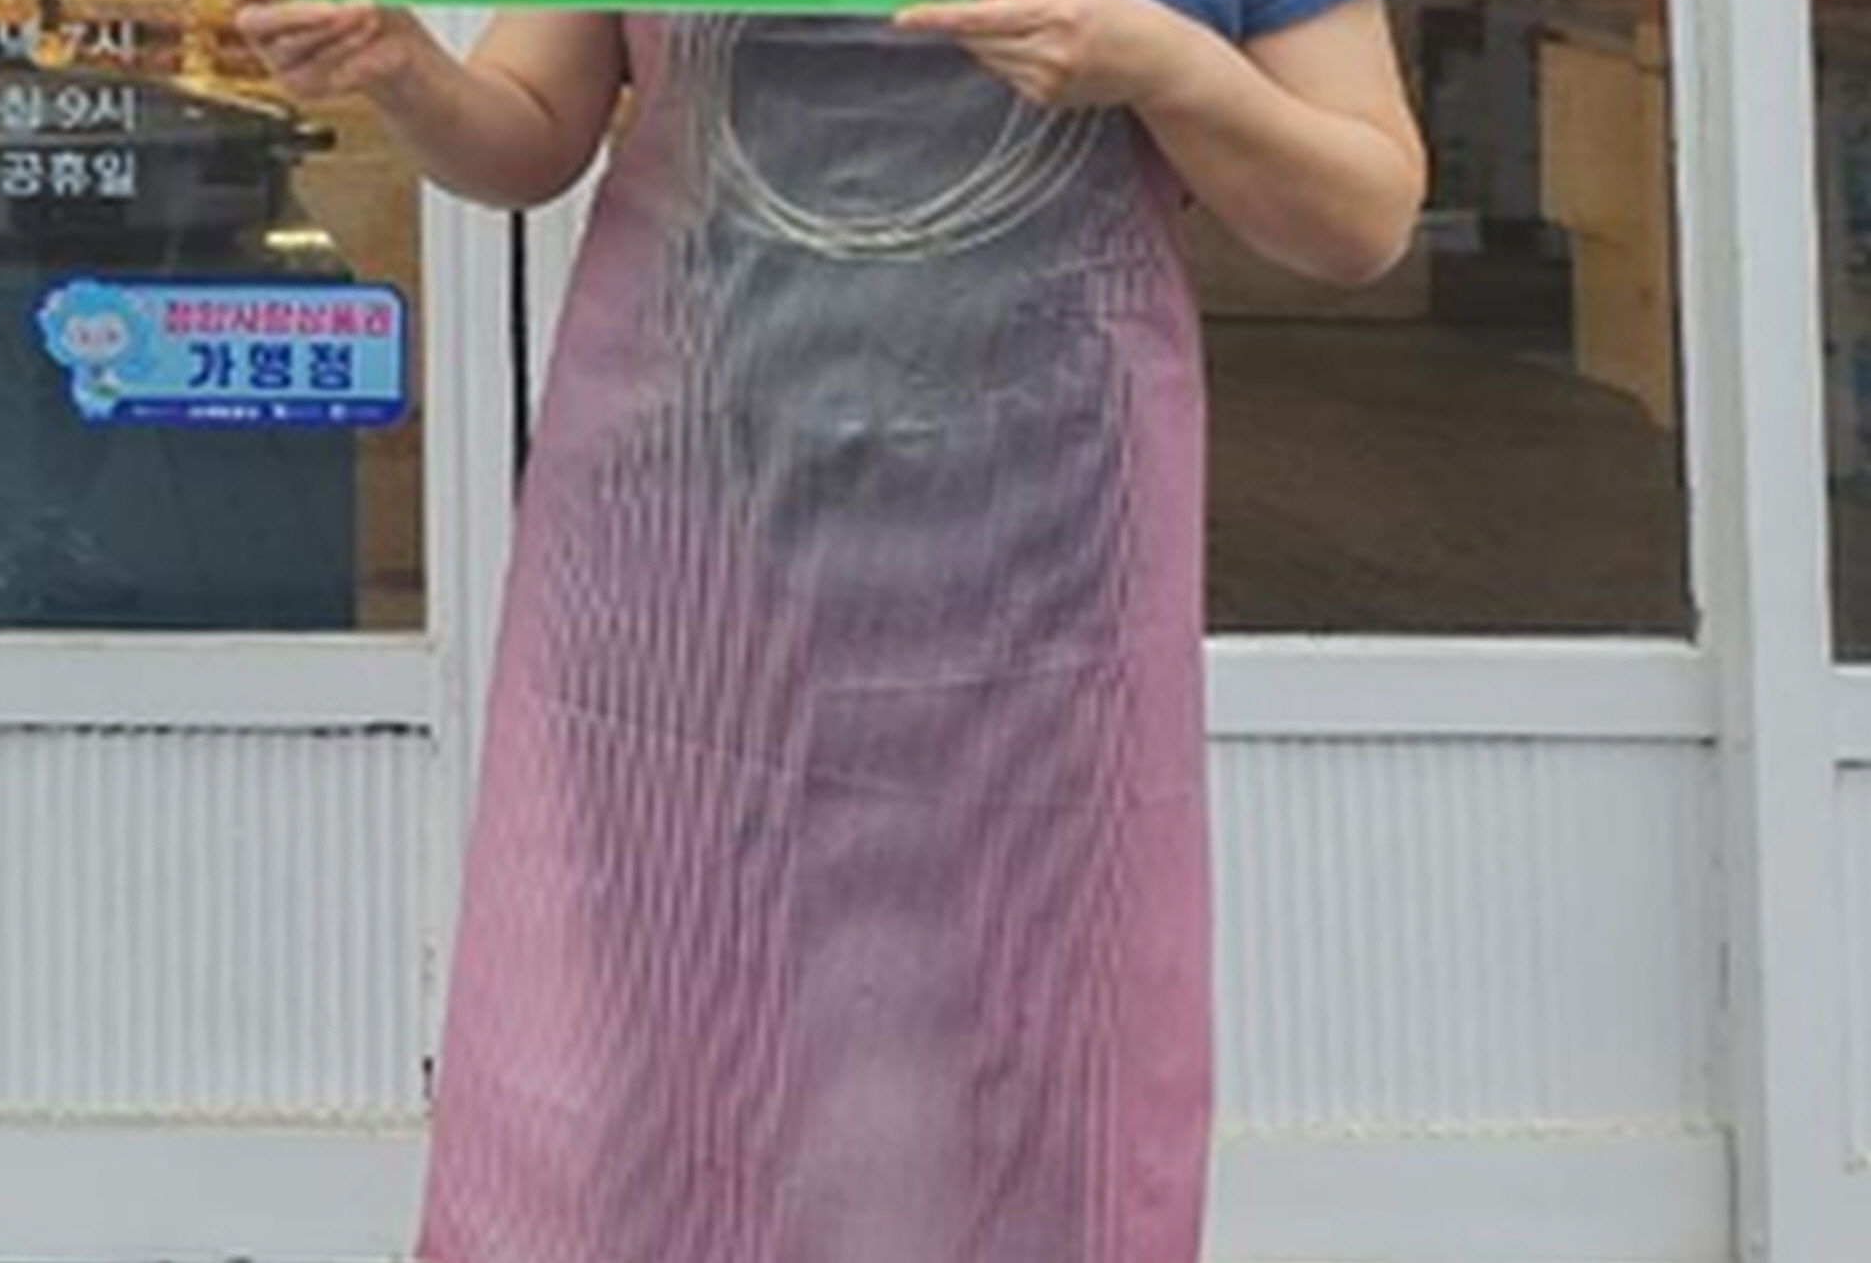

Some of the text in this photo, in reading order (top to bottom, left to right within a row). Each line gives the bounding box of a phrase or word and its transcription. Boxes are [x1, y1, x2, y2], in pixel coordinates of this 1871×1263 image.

[58, 18, 135, 64] 7시
[56, 85, 135, 132] 9시
[0, 149, 136, 197] 공휴일
[188, 342, 354, 389] 가맹점
